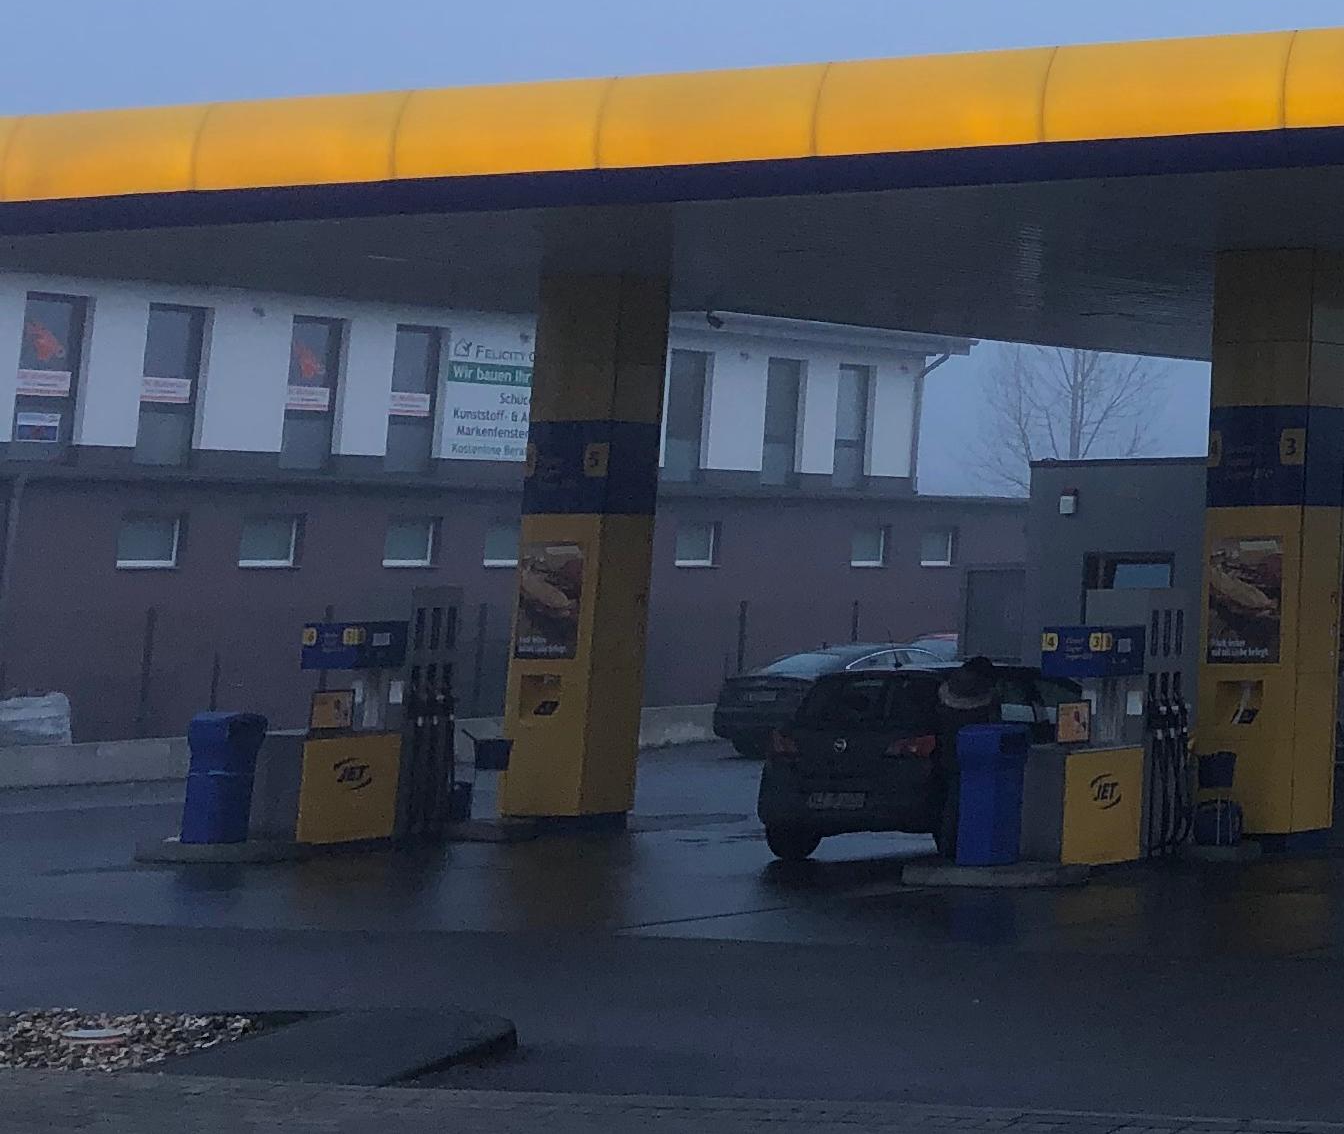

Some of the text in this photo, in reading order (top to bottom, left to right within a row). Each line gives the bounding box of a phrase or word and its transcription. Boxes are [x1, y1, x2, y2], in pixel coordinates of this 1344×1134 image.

[453, 365, 474, 379] Wir
[476, 366, 512, 382] bauen
[1285, 437, 1297, 456] 3
[1093, 782, 1118, 800] JET
